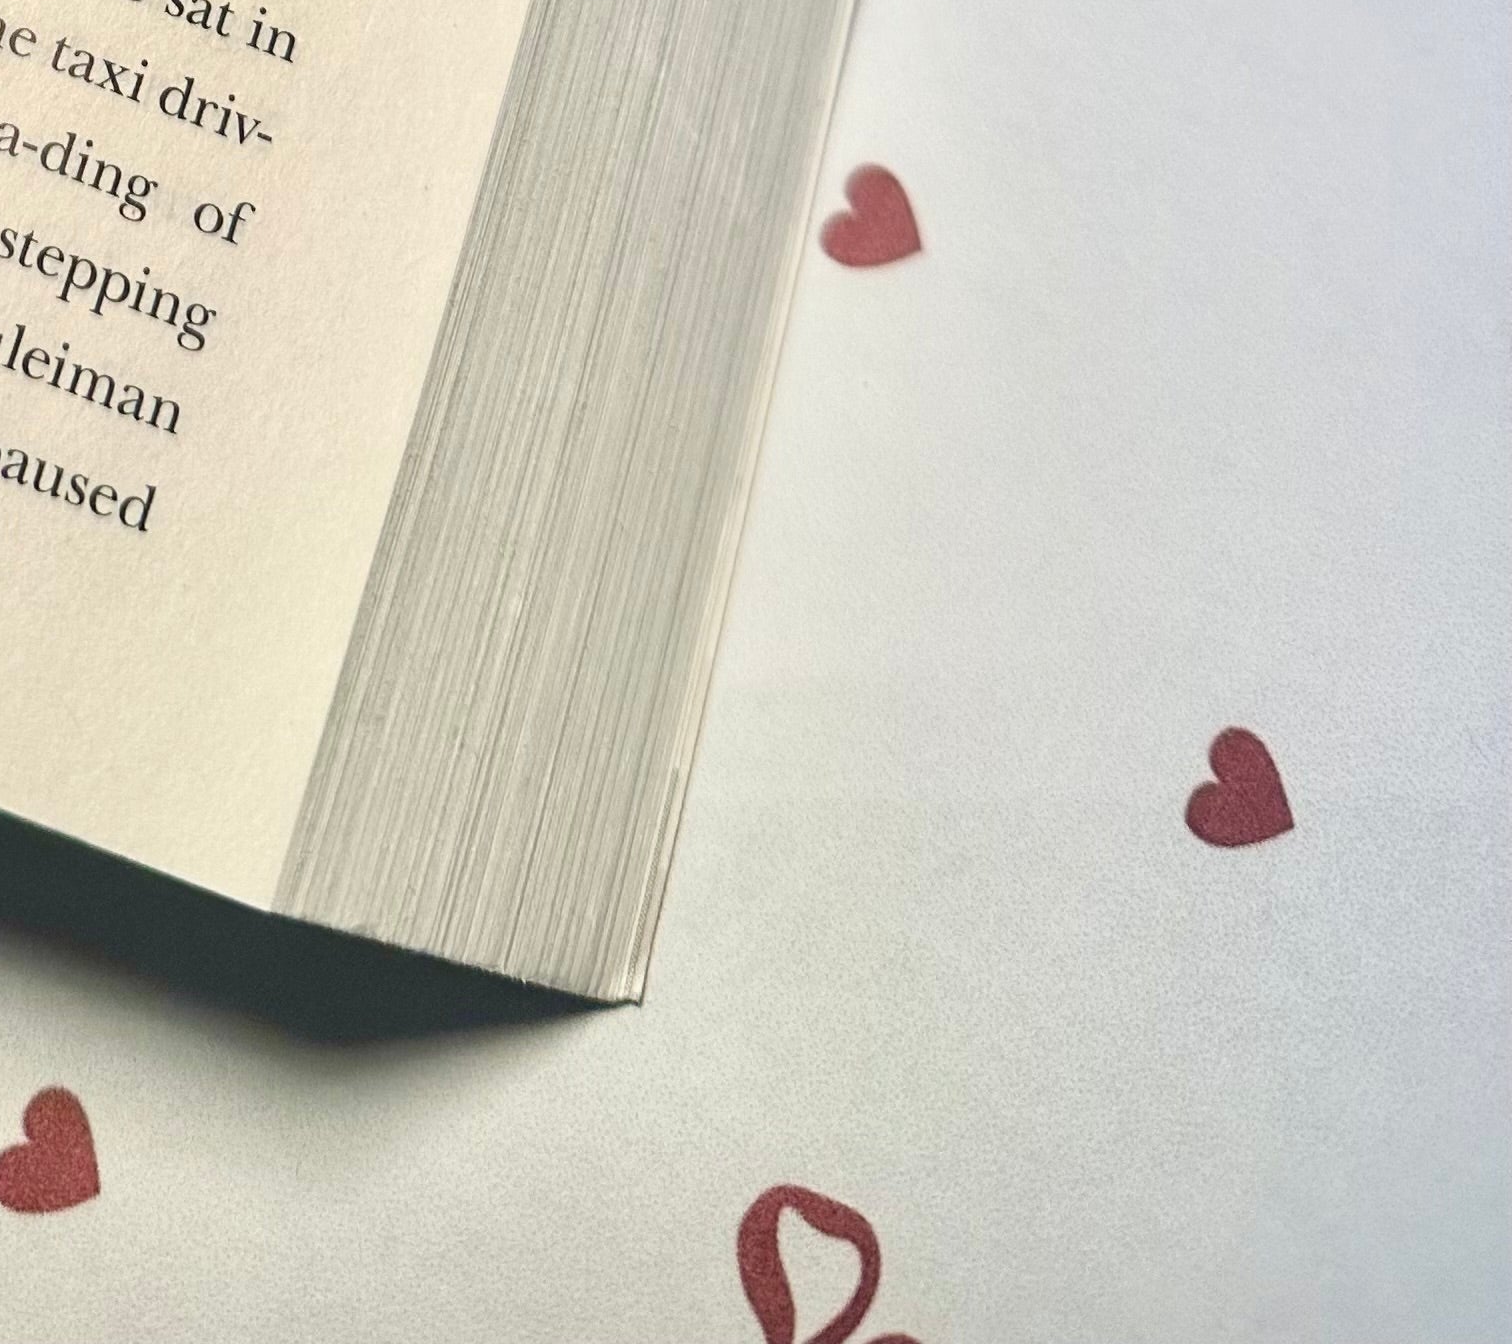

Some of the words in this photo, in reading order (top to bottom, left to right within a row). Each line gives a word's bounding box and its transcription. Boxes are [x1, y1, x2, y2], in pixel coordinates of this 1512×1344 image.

[52, 38, 148, 103] taxi
[159, 77, 272, 144] driv-
[194, 202, 256, 245] of
